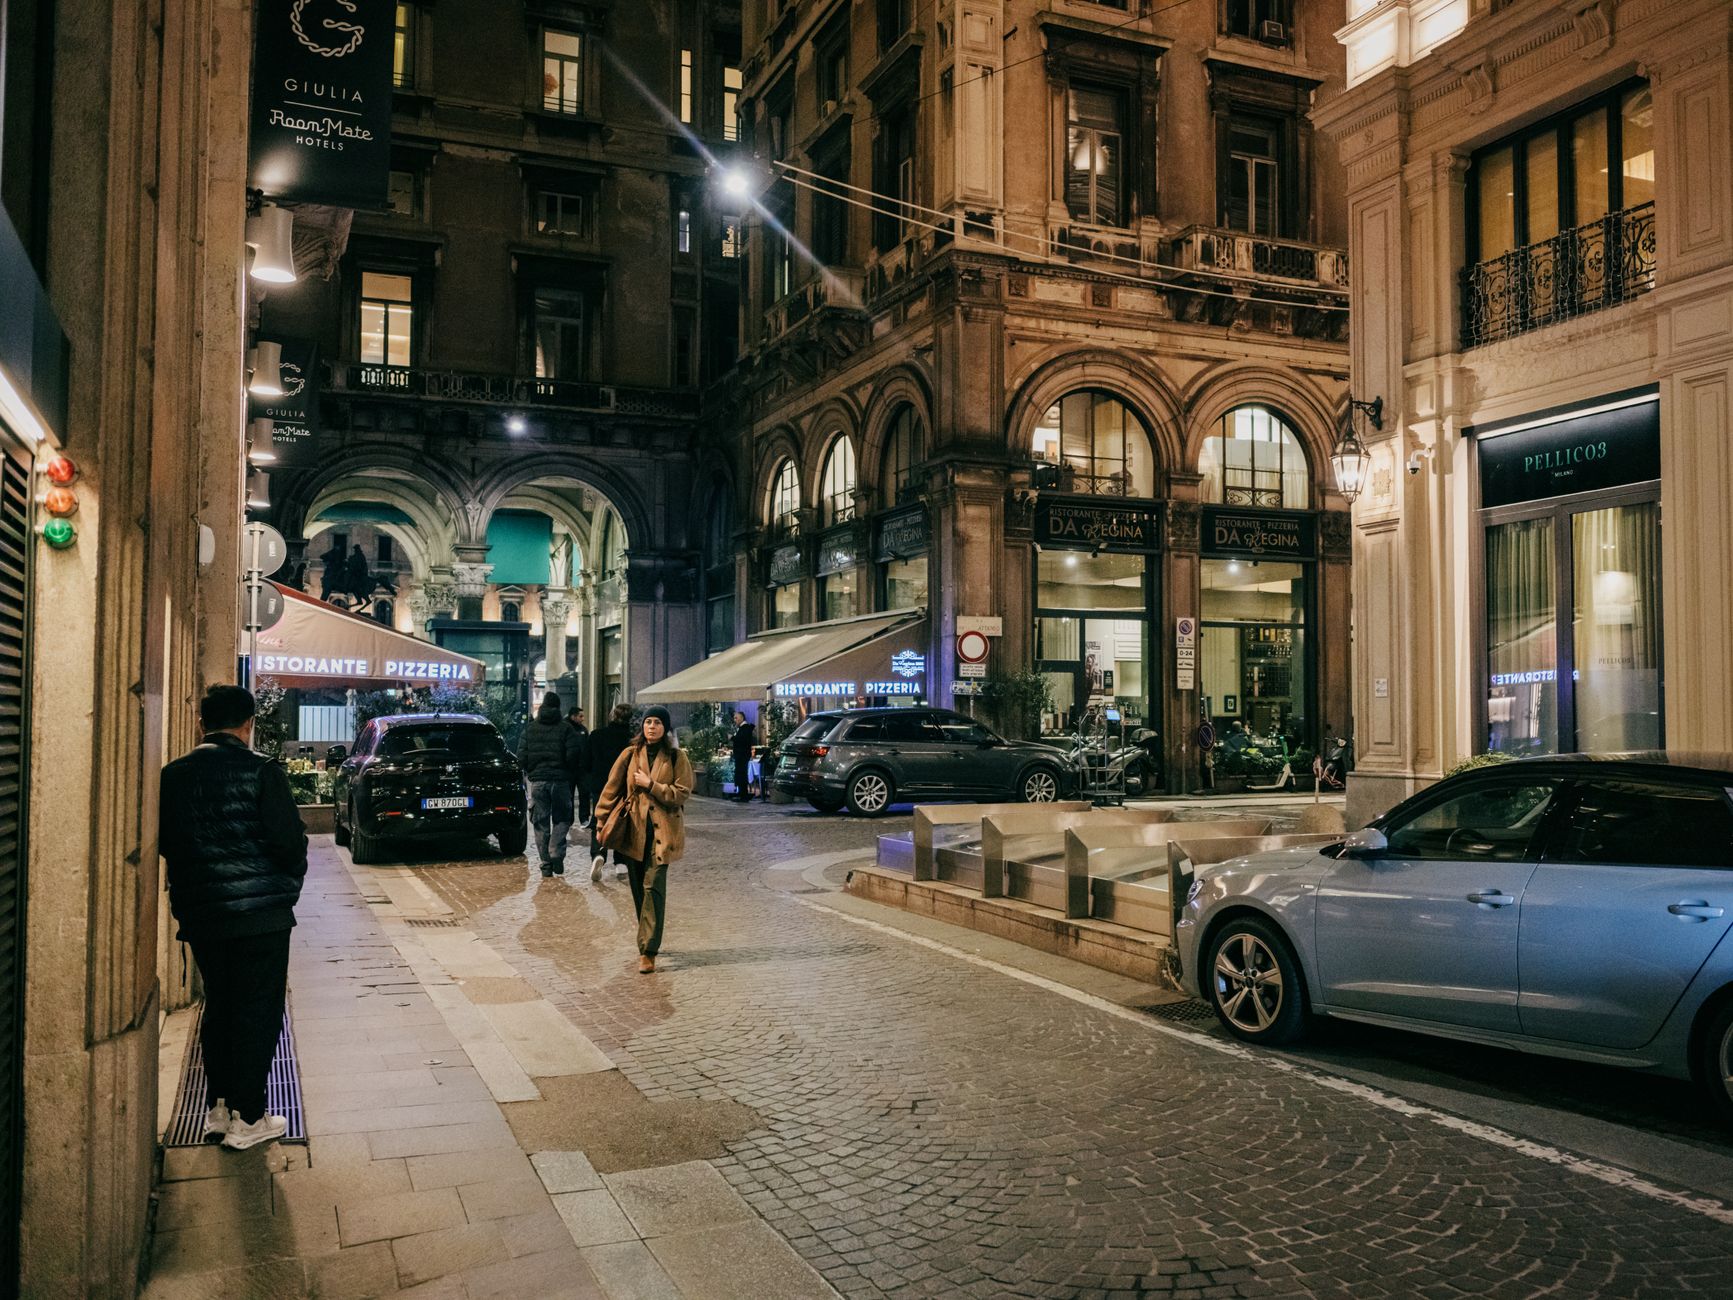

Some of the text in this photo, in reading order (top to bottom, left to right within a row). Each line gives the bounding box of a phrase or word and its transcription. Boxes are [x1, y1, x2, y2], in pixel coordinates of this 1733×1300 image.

[285, 78, 363, 103] GIULIA
[296, 136, 343, 150] HOTELS
[266, 408, 305, 417] GIULIA
[1524, 441, 1607, 472] PELLICO3
[1554, 469, 1574, 477] MILANO
[1050, 508, 1100, 518] RISTORANTE
[1050, 516, 1078, 536] DA
[1216, 519, 1260, 529] RISTORANTE
[1268, 521, 1299, 531] PIZZERIA
[1216, 527, 1240, 544] DA
[257, 656, 470, 680] ISTORANTE PIZZERIA
[776, 682, 921, 695] RISTORANTE PIZZERIA
